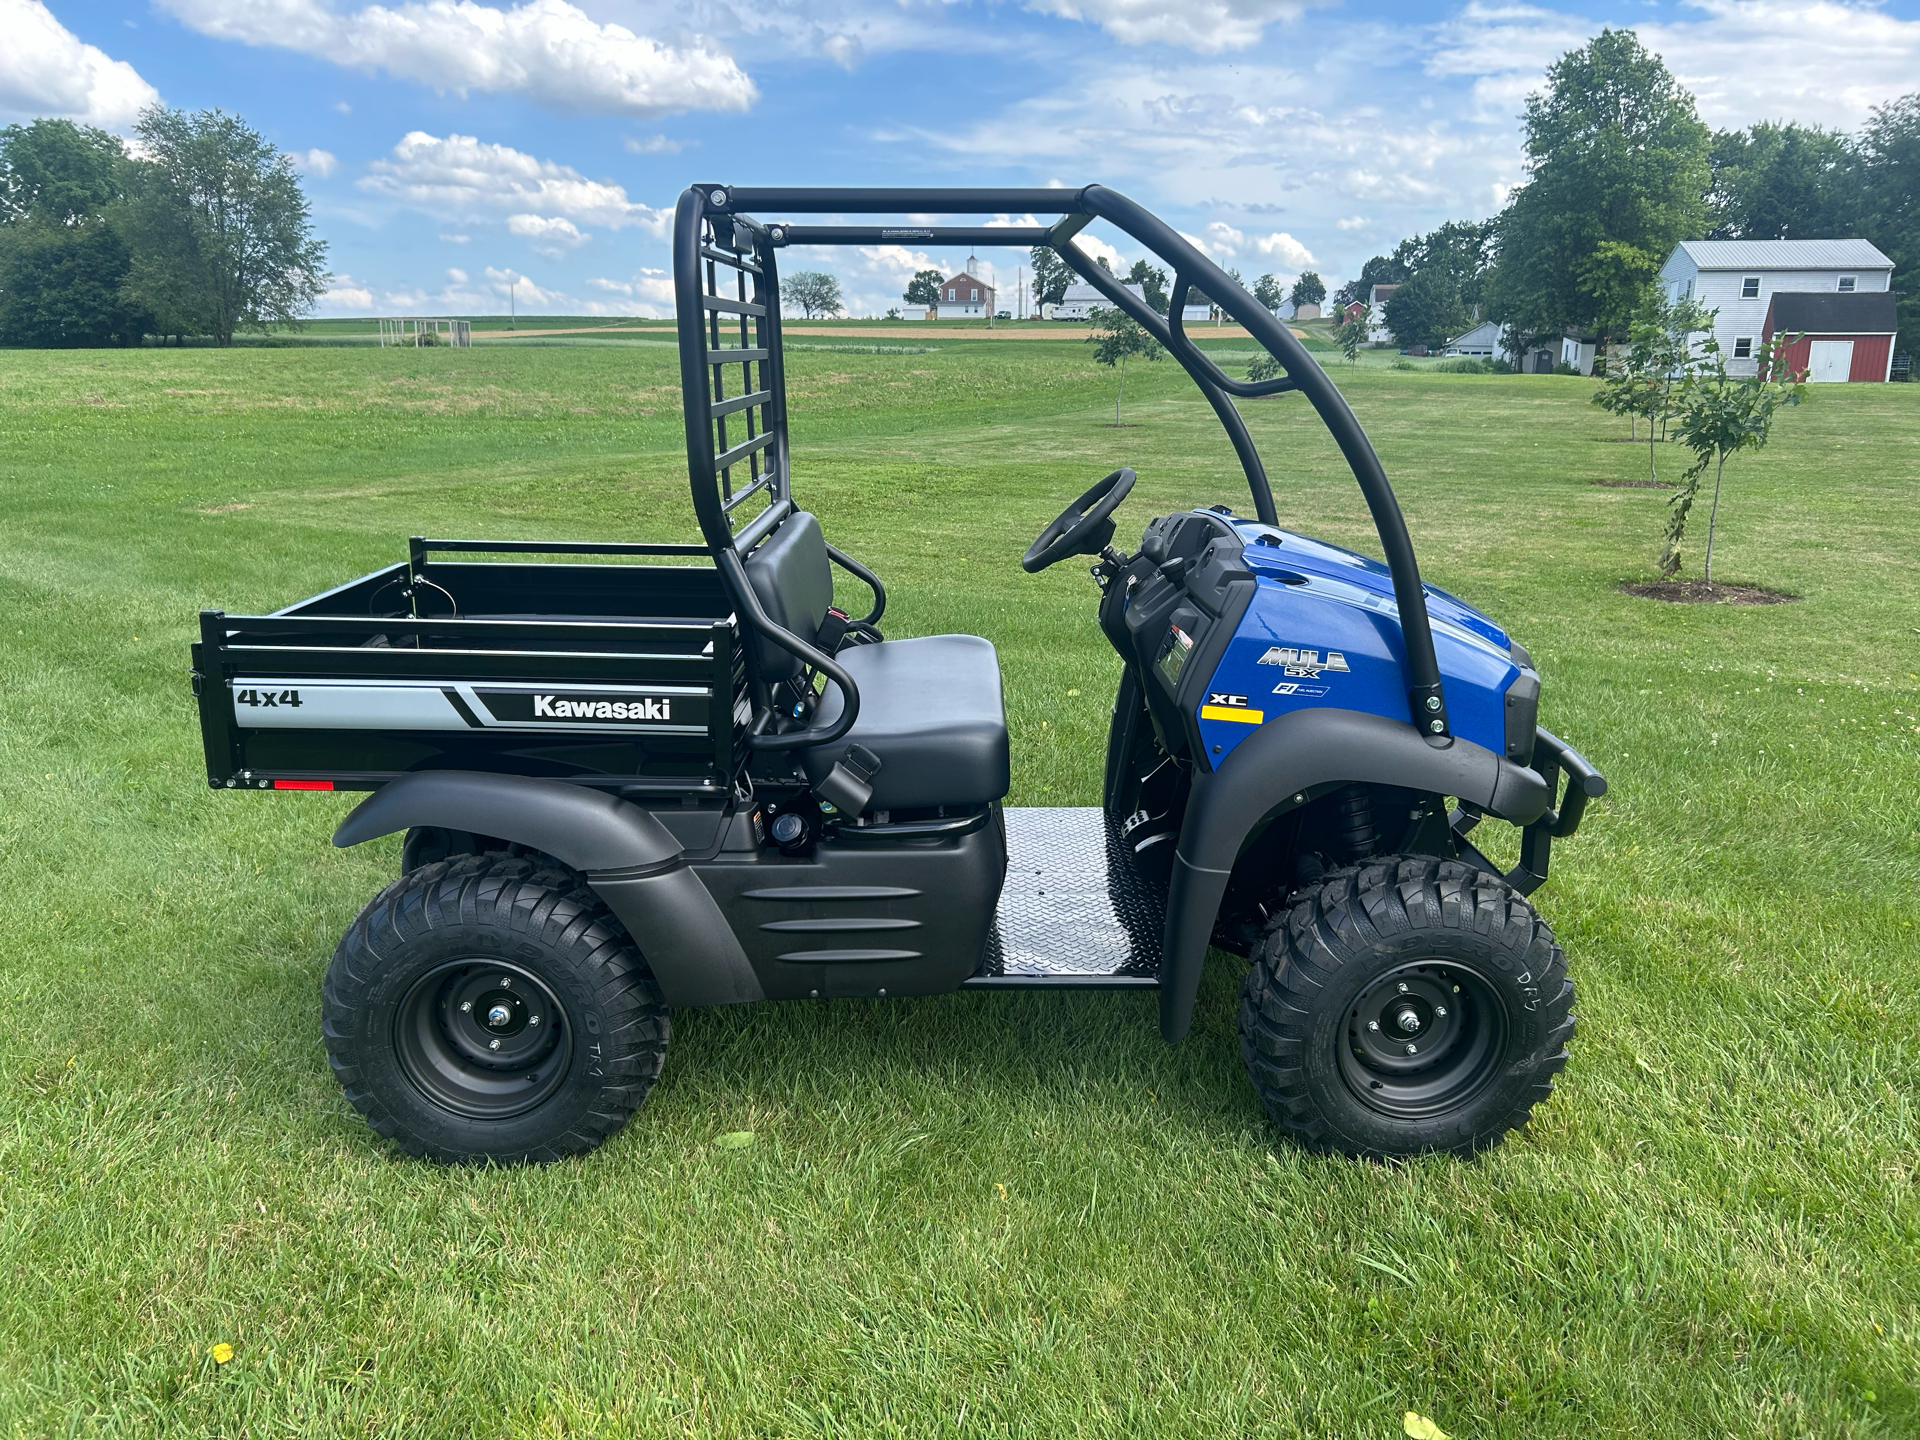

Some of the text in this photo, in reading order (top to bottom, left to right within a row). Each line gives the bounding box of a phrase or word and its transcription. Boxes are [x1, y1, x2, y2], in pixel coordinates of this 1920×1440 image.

[1257, 646, 1351, 672] MULE
[1284, 667, 1320, 679] SX
[237, 689, 304, 708] 4x4
[534, 695, 670, 720] Kawasaki
[1209, 693, 1248, 706] XC
